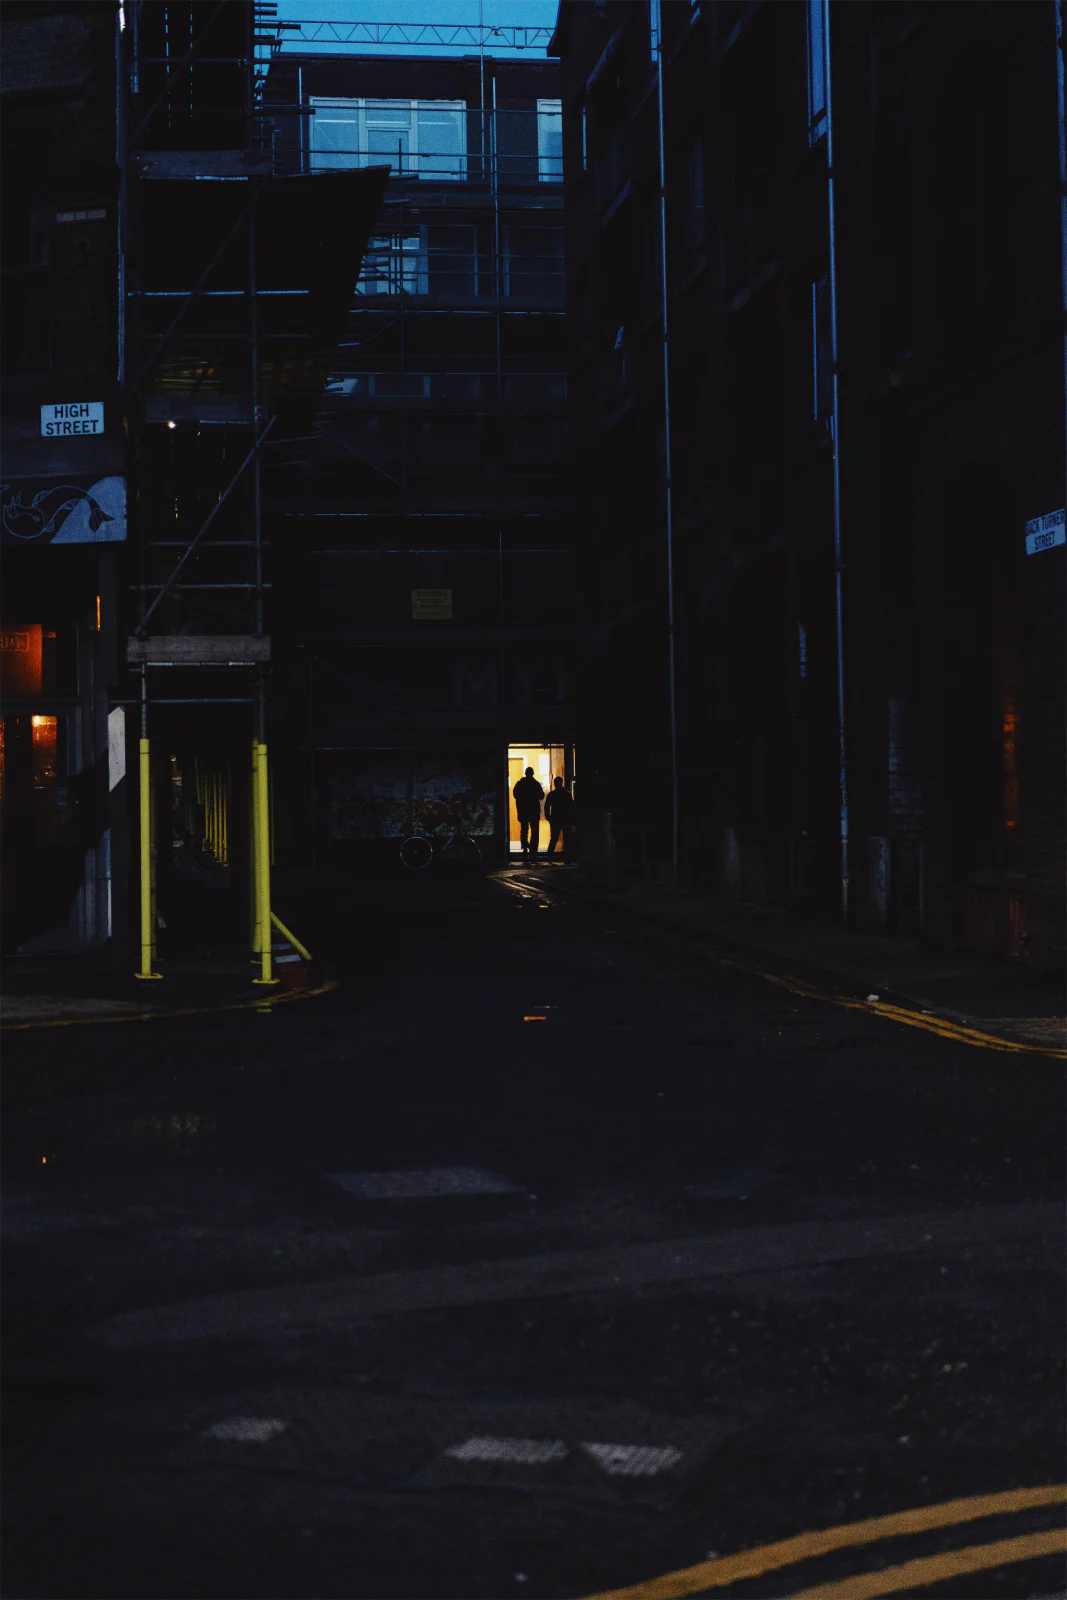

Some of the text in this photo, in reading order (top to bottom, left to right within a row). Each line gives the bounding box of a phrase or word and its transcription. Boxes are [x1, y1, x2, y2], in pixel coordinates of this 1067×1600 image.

[55, 404, 89, 418] HIGH
[46, 420, 98, 435] STREET
[1041, 511, 1065, 530] TURNER
[1035, 531, 1055, 549] STREET
